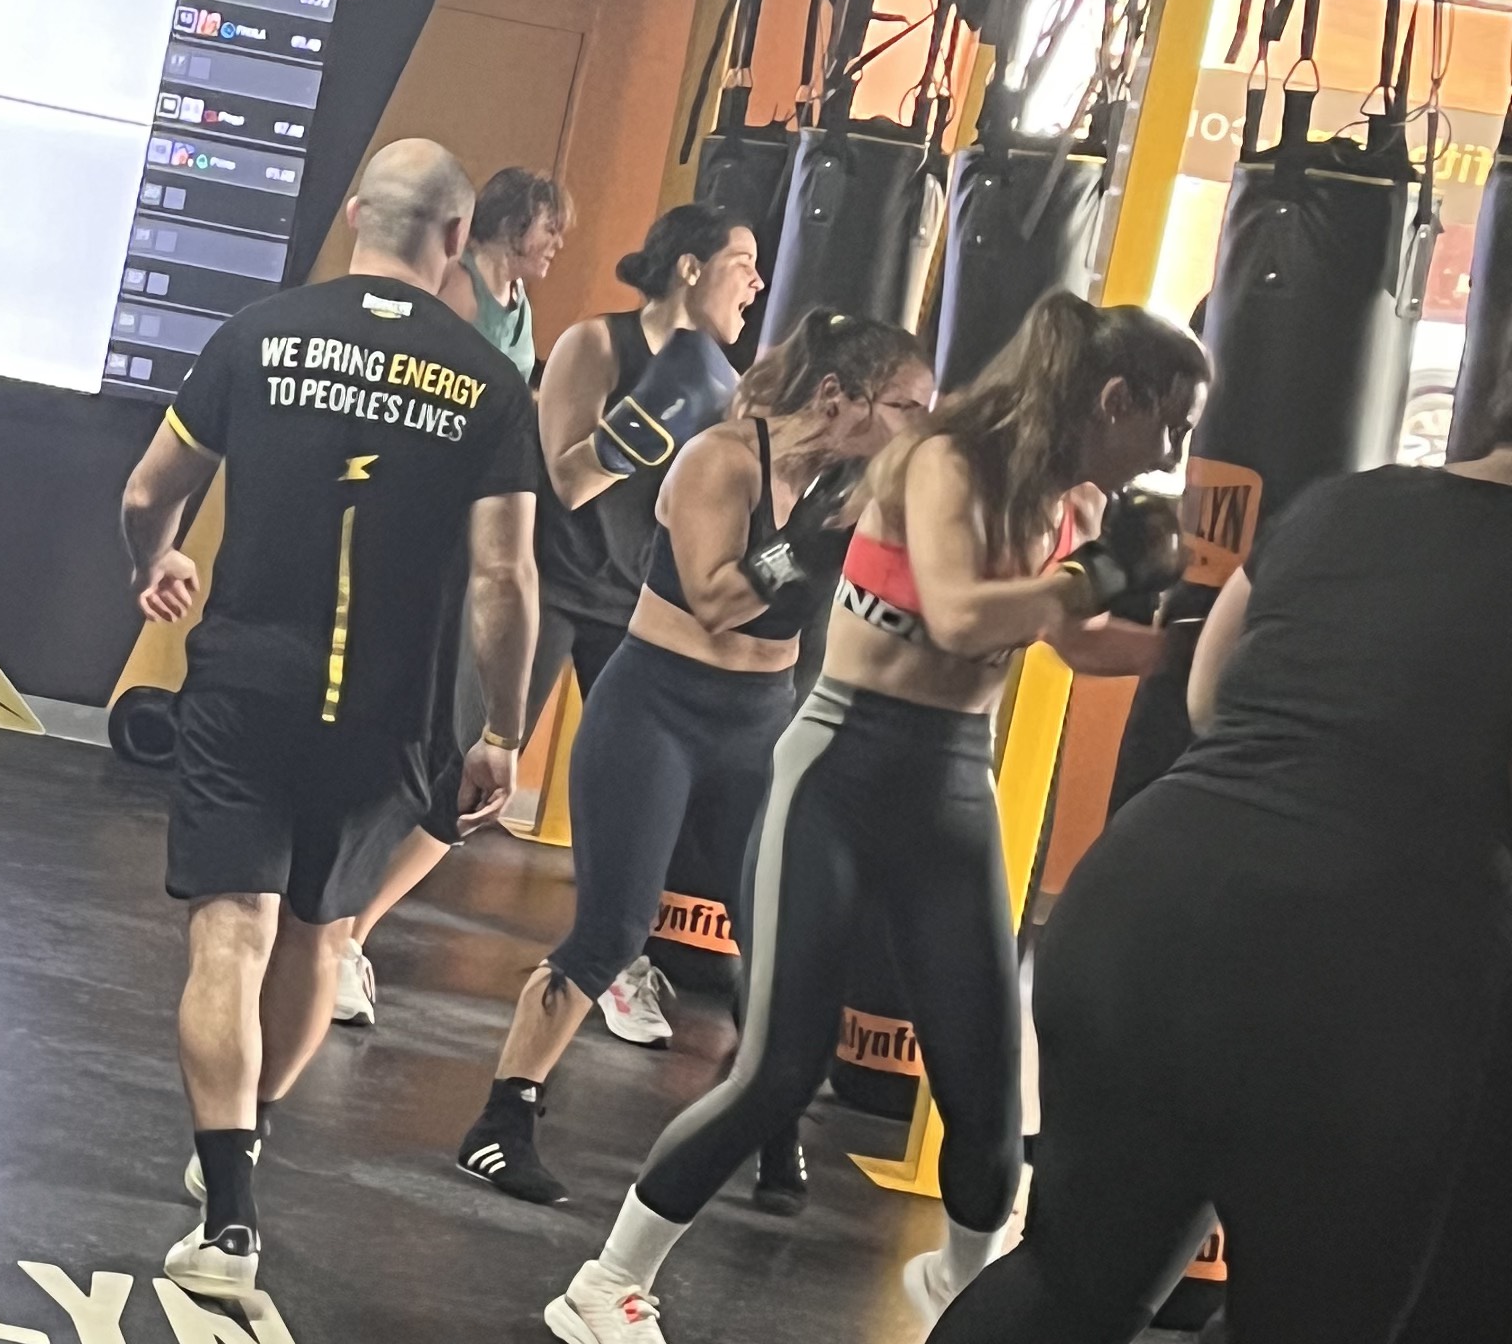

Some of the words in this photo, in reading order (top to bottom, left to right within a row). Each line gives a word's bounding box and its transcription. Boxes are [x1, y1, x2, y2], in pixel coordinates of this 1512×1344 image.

[261, 337, 302, 368] WE
[304, 337, 385, 382] BRING
[388, 353, 487, 409] ENERGY
[267, 377, 296, 406] TO
[403, 399, 467, 442] LIVES
